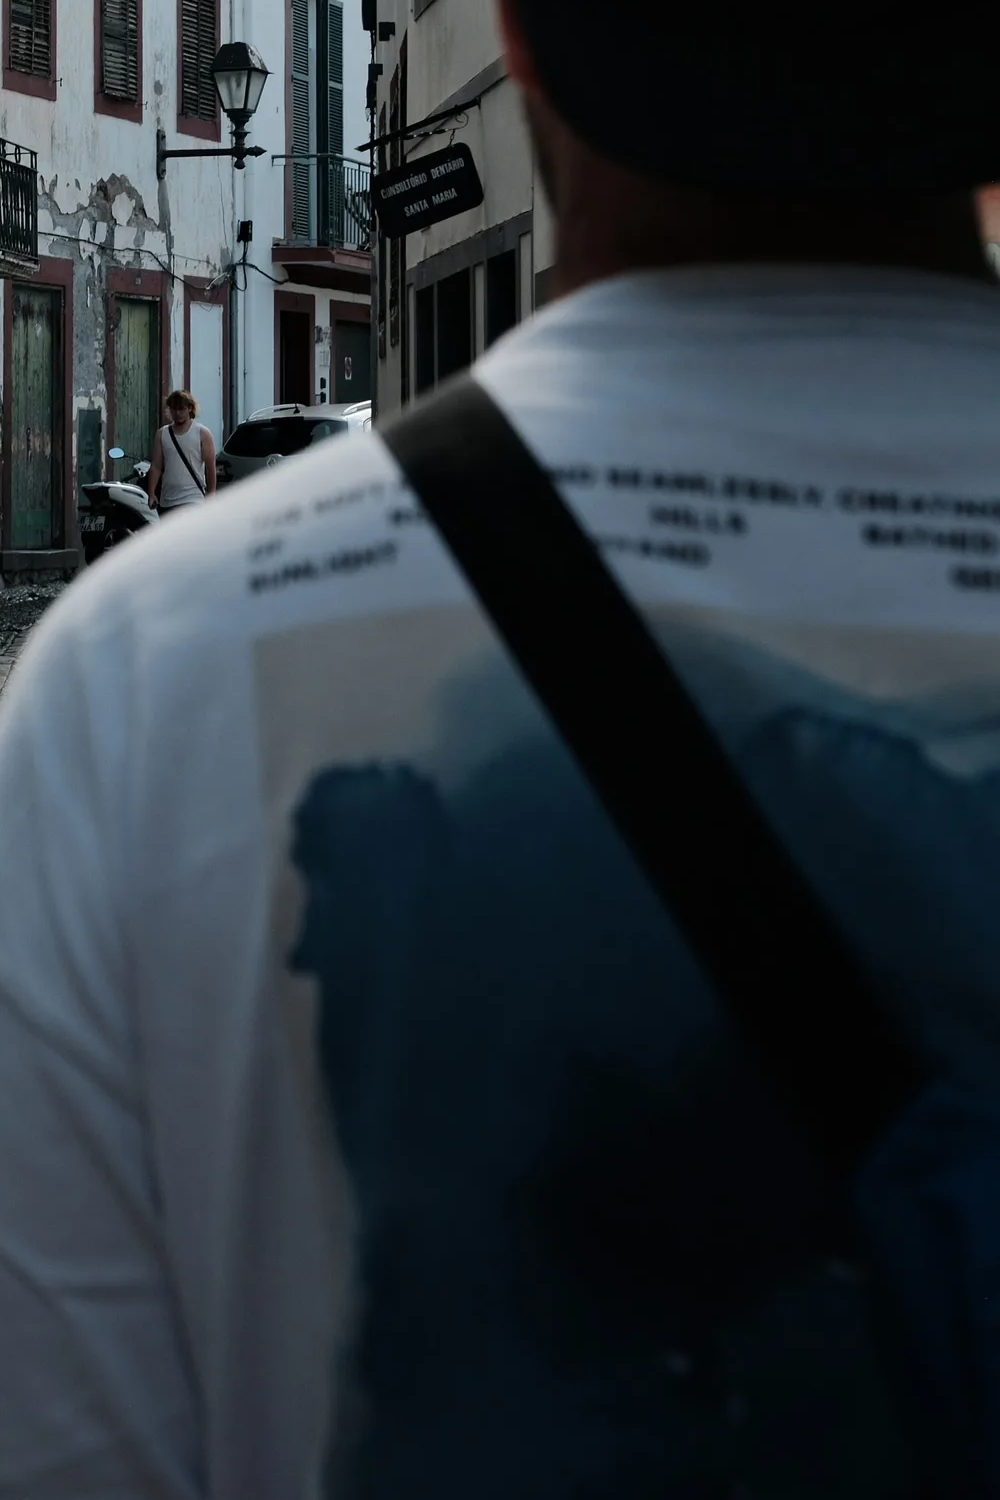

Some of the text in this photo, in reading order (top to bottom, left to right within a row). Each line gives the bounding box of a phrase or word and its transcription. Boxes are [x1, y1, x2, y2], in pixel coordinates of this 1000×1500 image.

[380, 157, 465, 199] CONSULTÓRIO DENTÁRIO
[403, 187, 458, 217] SANTA MARIA
